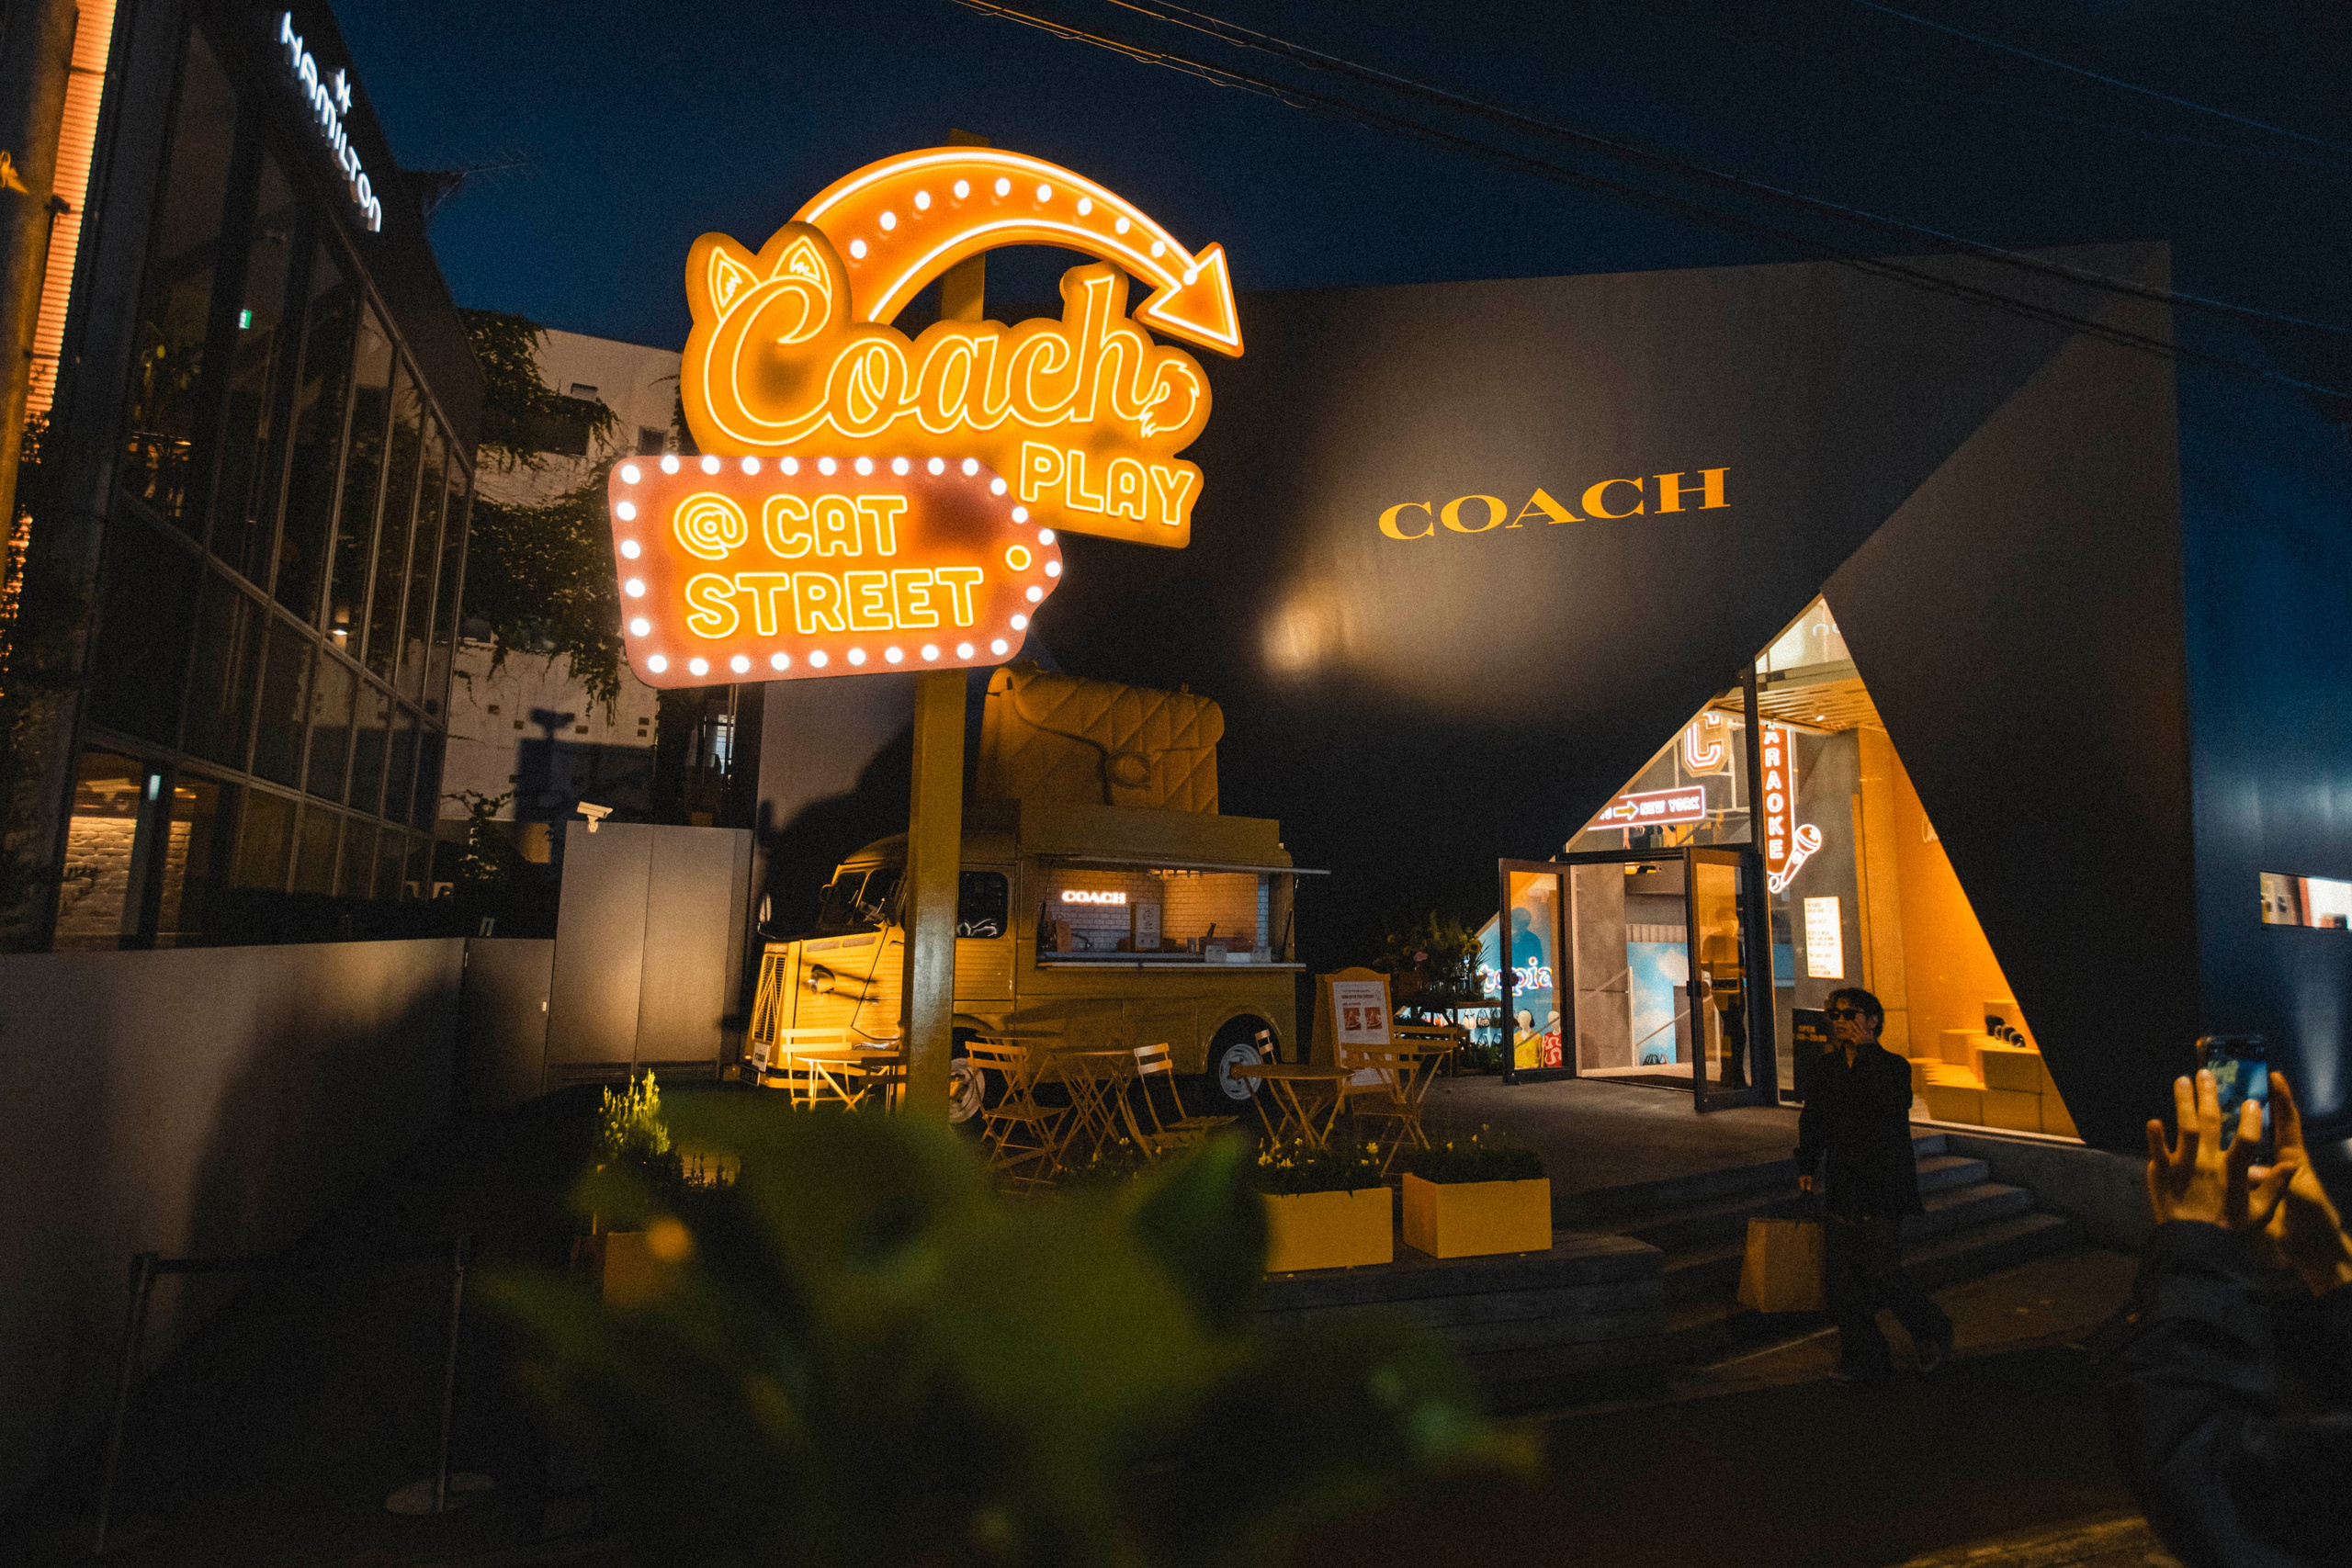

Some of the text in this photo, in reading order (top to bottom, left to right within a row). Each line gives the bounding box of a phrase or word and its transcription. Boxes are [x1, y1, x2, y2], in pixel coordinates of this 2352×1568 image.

[704, 274, 1200, 446] Coach
[1019, 441, 1195, 525] PLAY
[1378, 467, 1731, 540] COACH
[763, 493, 908, 558] CAT
[684, 568, 984, 639] STREET
[1668, 795, 1701, 812] YORK
[1763, 722, 1785, 860] ARAOKE
[1061, 890, 1126, 905] COACH
